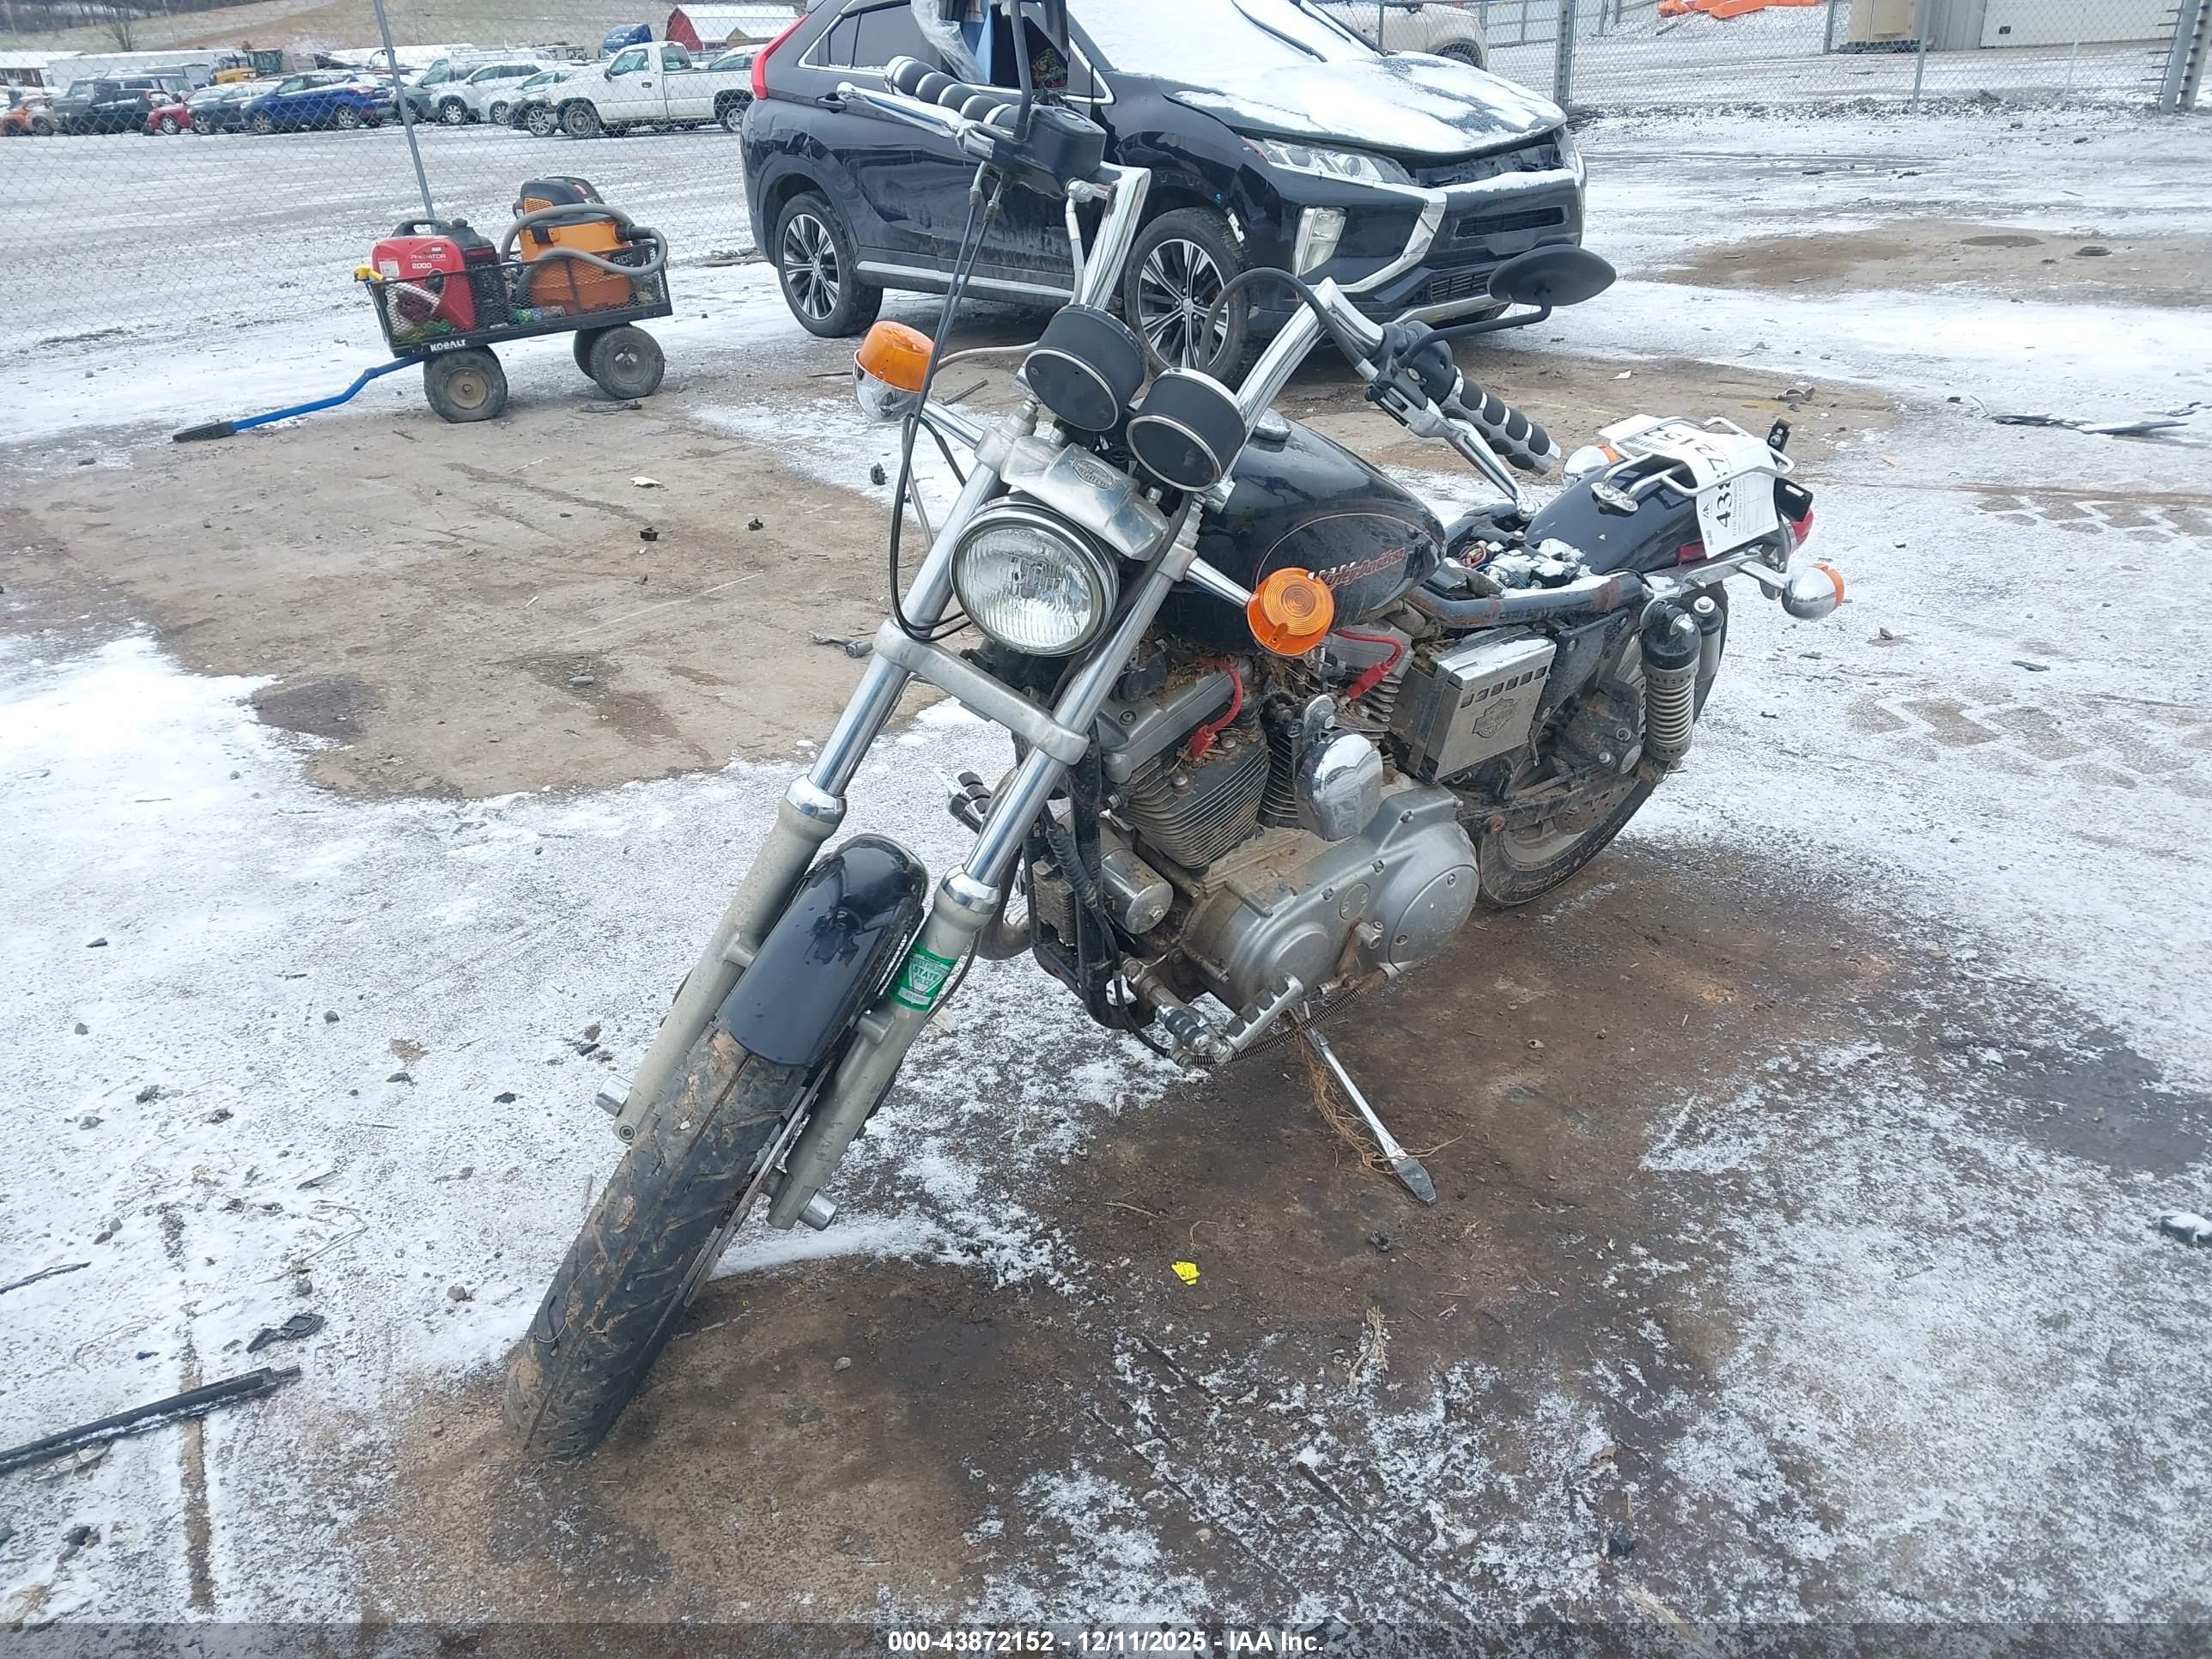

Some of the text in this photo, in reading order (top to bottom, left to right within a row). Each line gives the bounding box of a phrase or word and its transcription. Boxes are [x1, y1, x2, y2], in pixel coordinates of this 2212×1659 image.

[430, 339, 466, 353] KOBALT
[913, 965, 940, 981] STATE
[914, 975, 933, 987] POLICE
